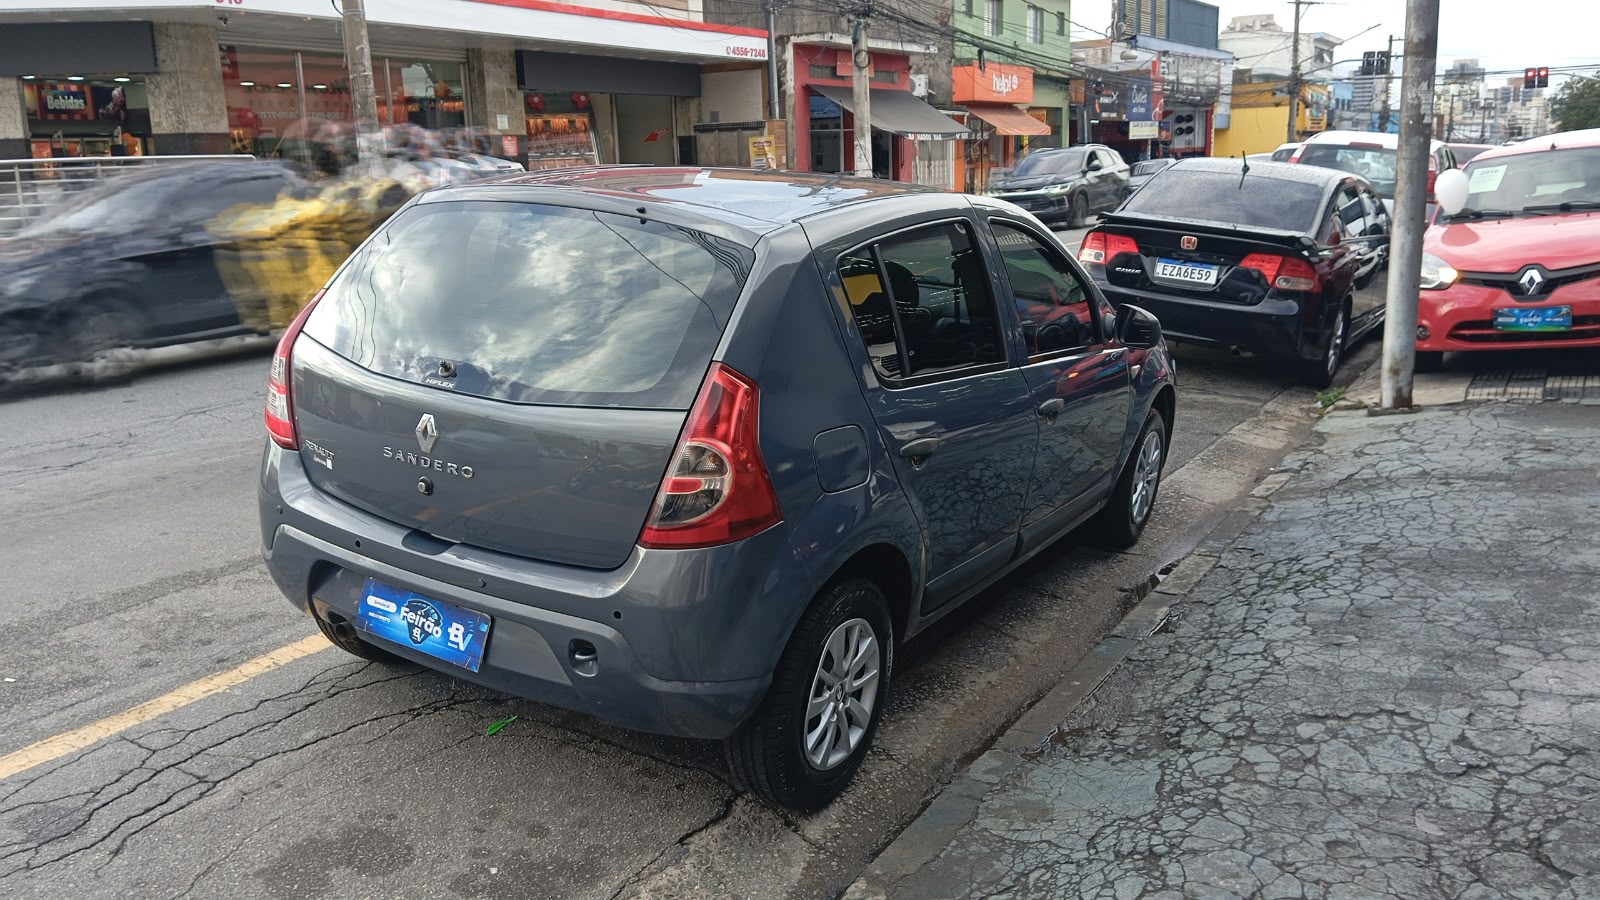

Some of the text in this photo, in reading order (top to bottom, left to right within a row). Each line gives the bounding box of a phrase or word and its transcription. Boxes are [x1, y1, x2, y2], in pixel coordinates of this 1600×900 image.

[46, 95, 85, 110] Bebidas
[1161, 264, 1212, 282] EZA6E59
[382, 446, 475, 479] SANDERO
[400, 605, 442, 639] Feirão
